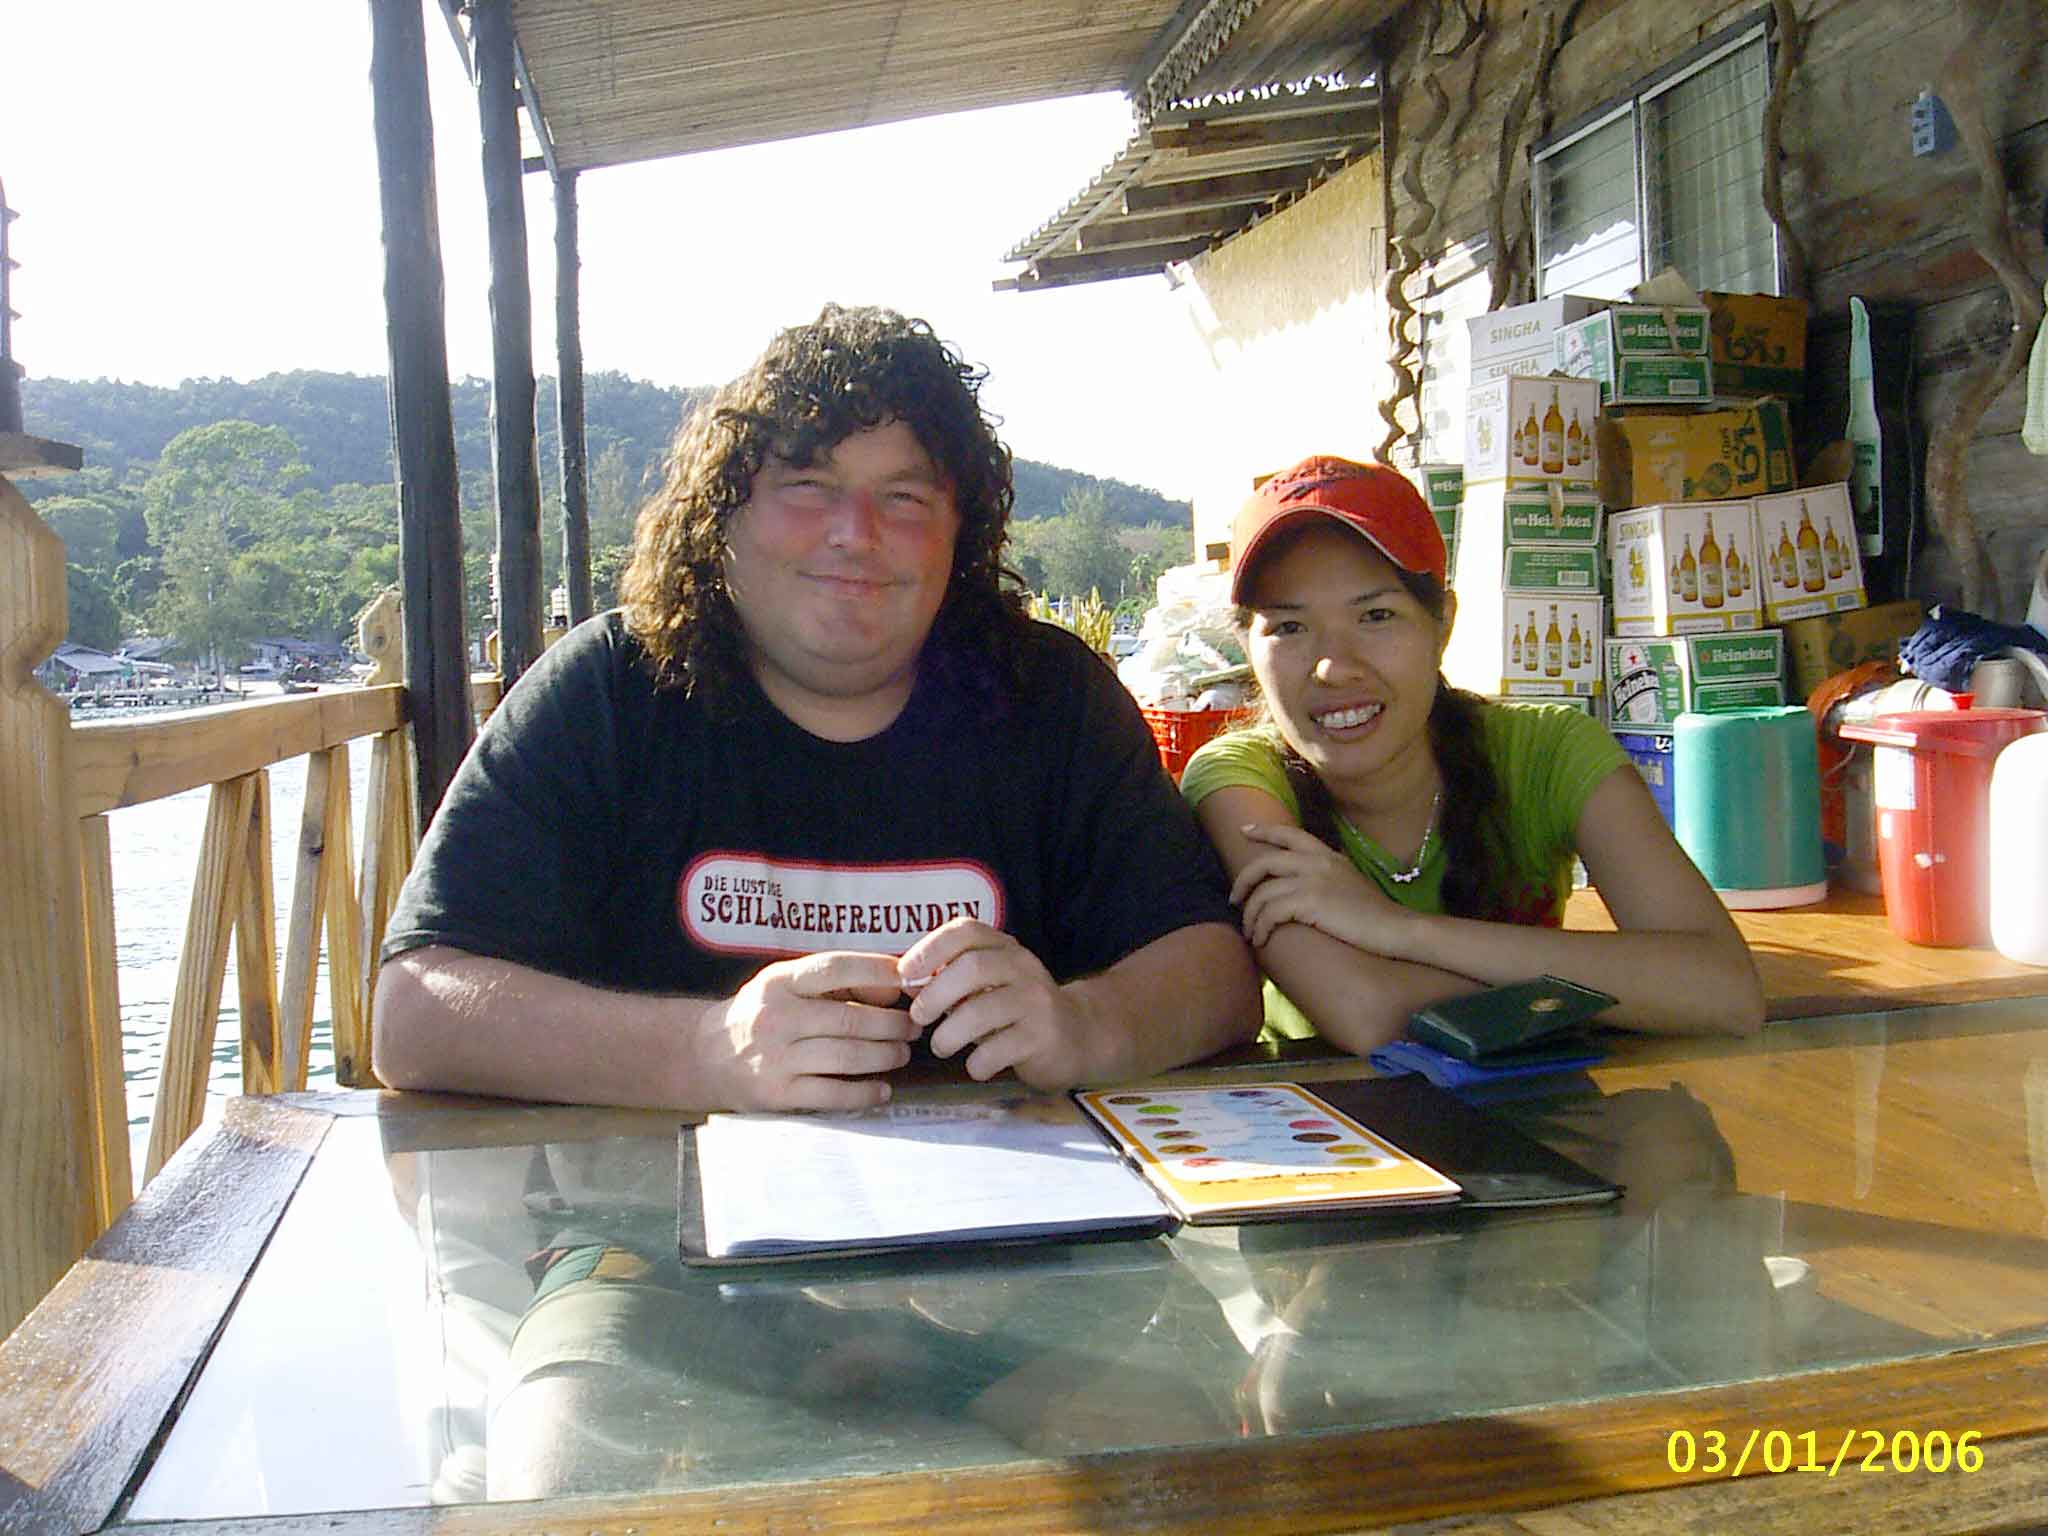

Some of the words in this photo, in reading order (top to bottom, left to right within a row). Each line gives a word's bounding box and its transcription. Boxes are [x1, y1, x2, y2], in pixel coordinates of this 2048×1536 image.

[1489, 320, 1541, 344] SINGHA
[1637, 323, 1699, 338] Heinen
[1528, 512, 1592, 528] Heiken
[1712, 648, 1774, 662] Heineken
[704, 875, 727, 891] DIE
